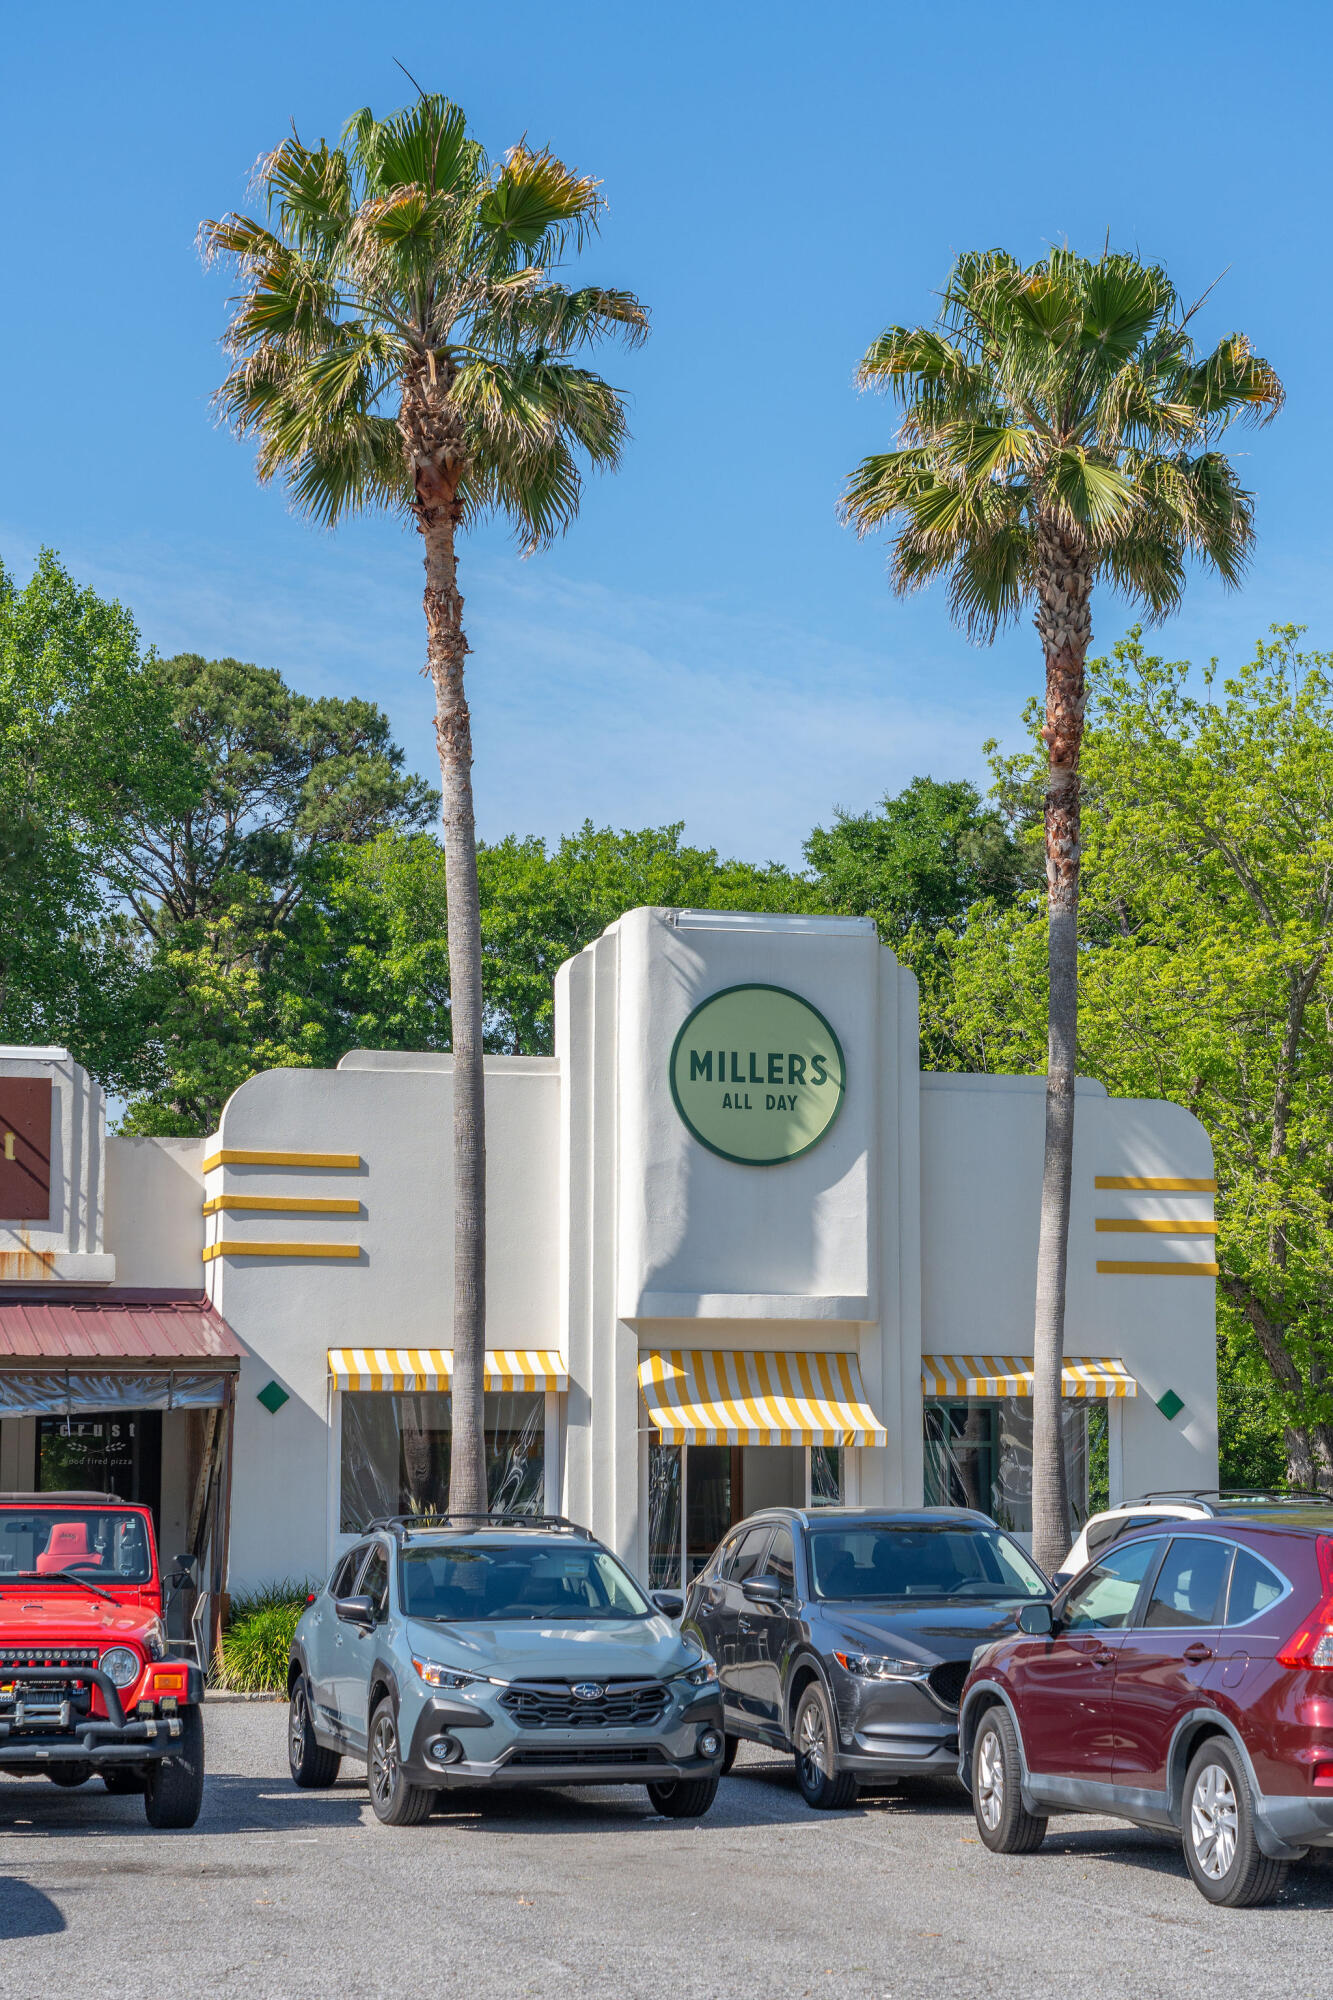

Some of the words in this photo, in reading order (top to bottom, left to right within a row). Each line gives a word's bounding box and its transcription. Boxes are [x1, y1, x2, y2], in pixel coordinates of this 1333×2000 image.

[690, 1050, 828, 1086] MILLERS
[722, 1093, 752, 1110] ALL
[765, 1094, 798, 1111] DAY
[60, 1423, 135, 1437] crust
[87, 1457, 108, 1465] fired
[110, 1458, 133, 1467] pizza
